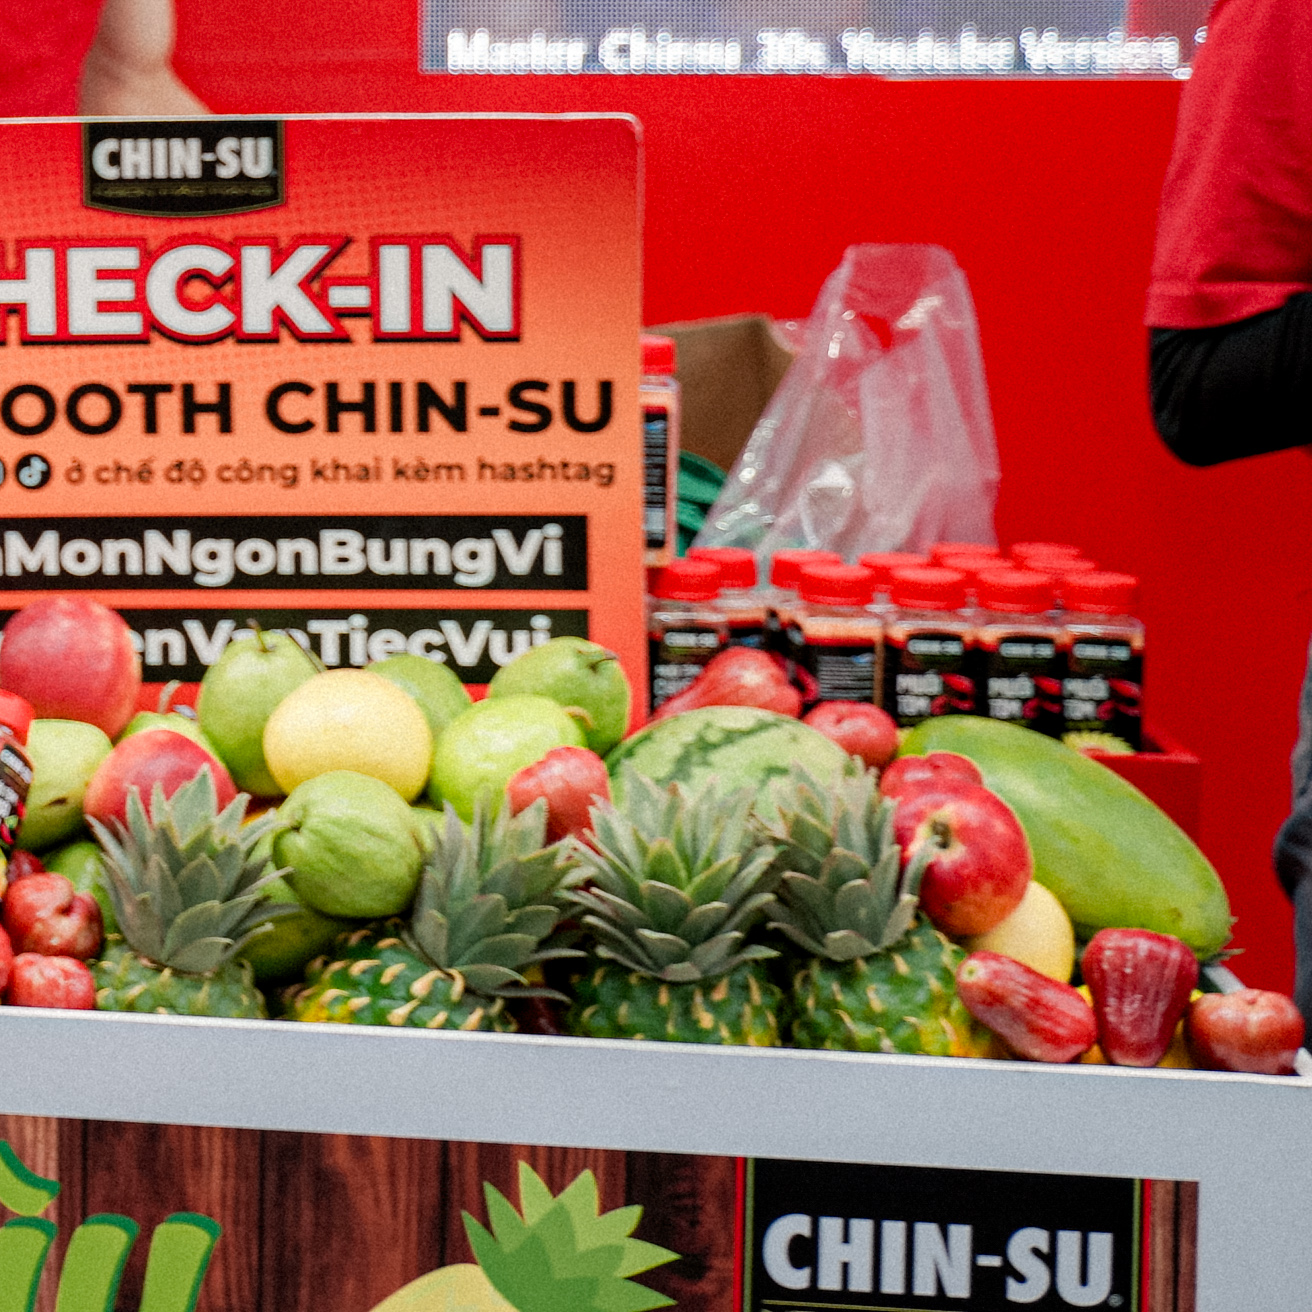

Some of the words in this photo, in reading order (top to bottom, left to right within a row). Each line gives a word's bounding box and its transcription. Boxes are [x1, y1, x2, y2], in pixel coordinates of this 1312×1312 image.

[92, 136, 274, 180] CHIN-SU
[264, 378, 615, 435] CHIN-SU
[93, 454, 154, 486] chế
[216, 455, 300, 492] công
[310, 452, 382, 485] khai
[476, 456, 618, 488] hashtag
[762, 1212, 1115, 1308] CHIN-SU
